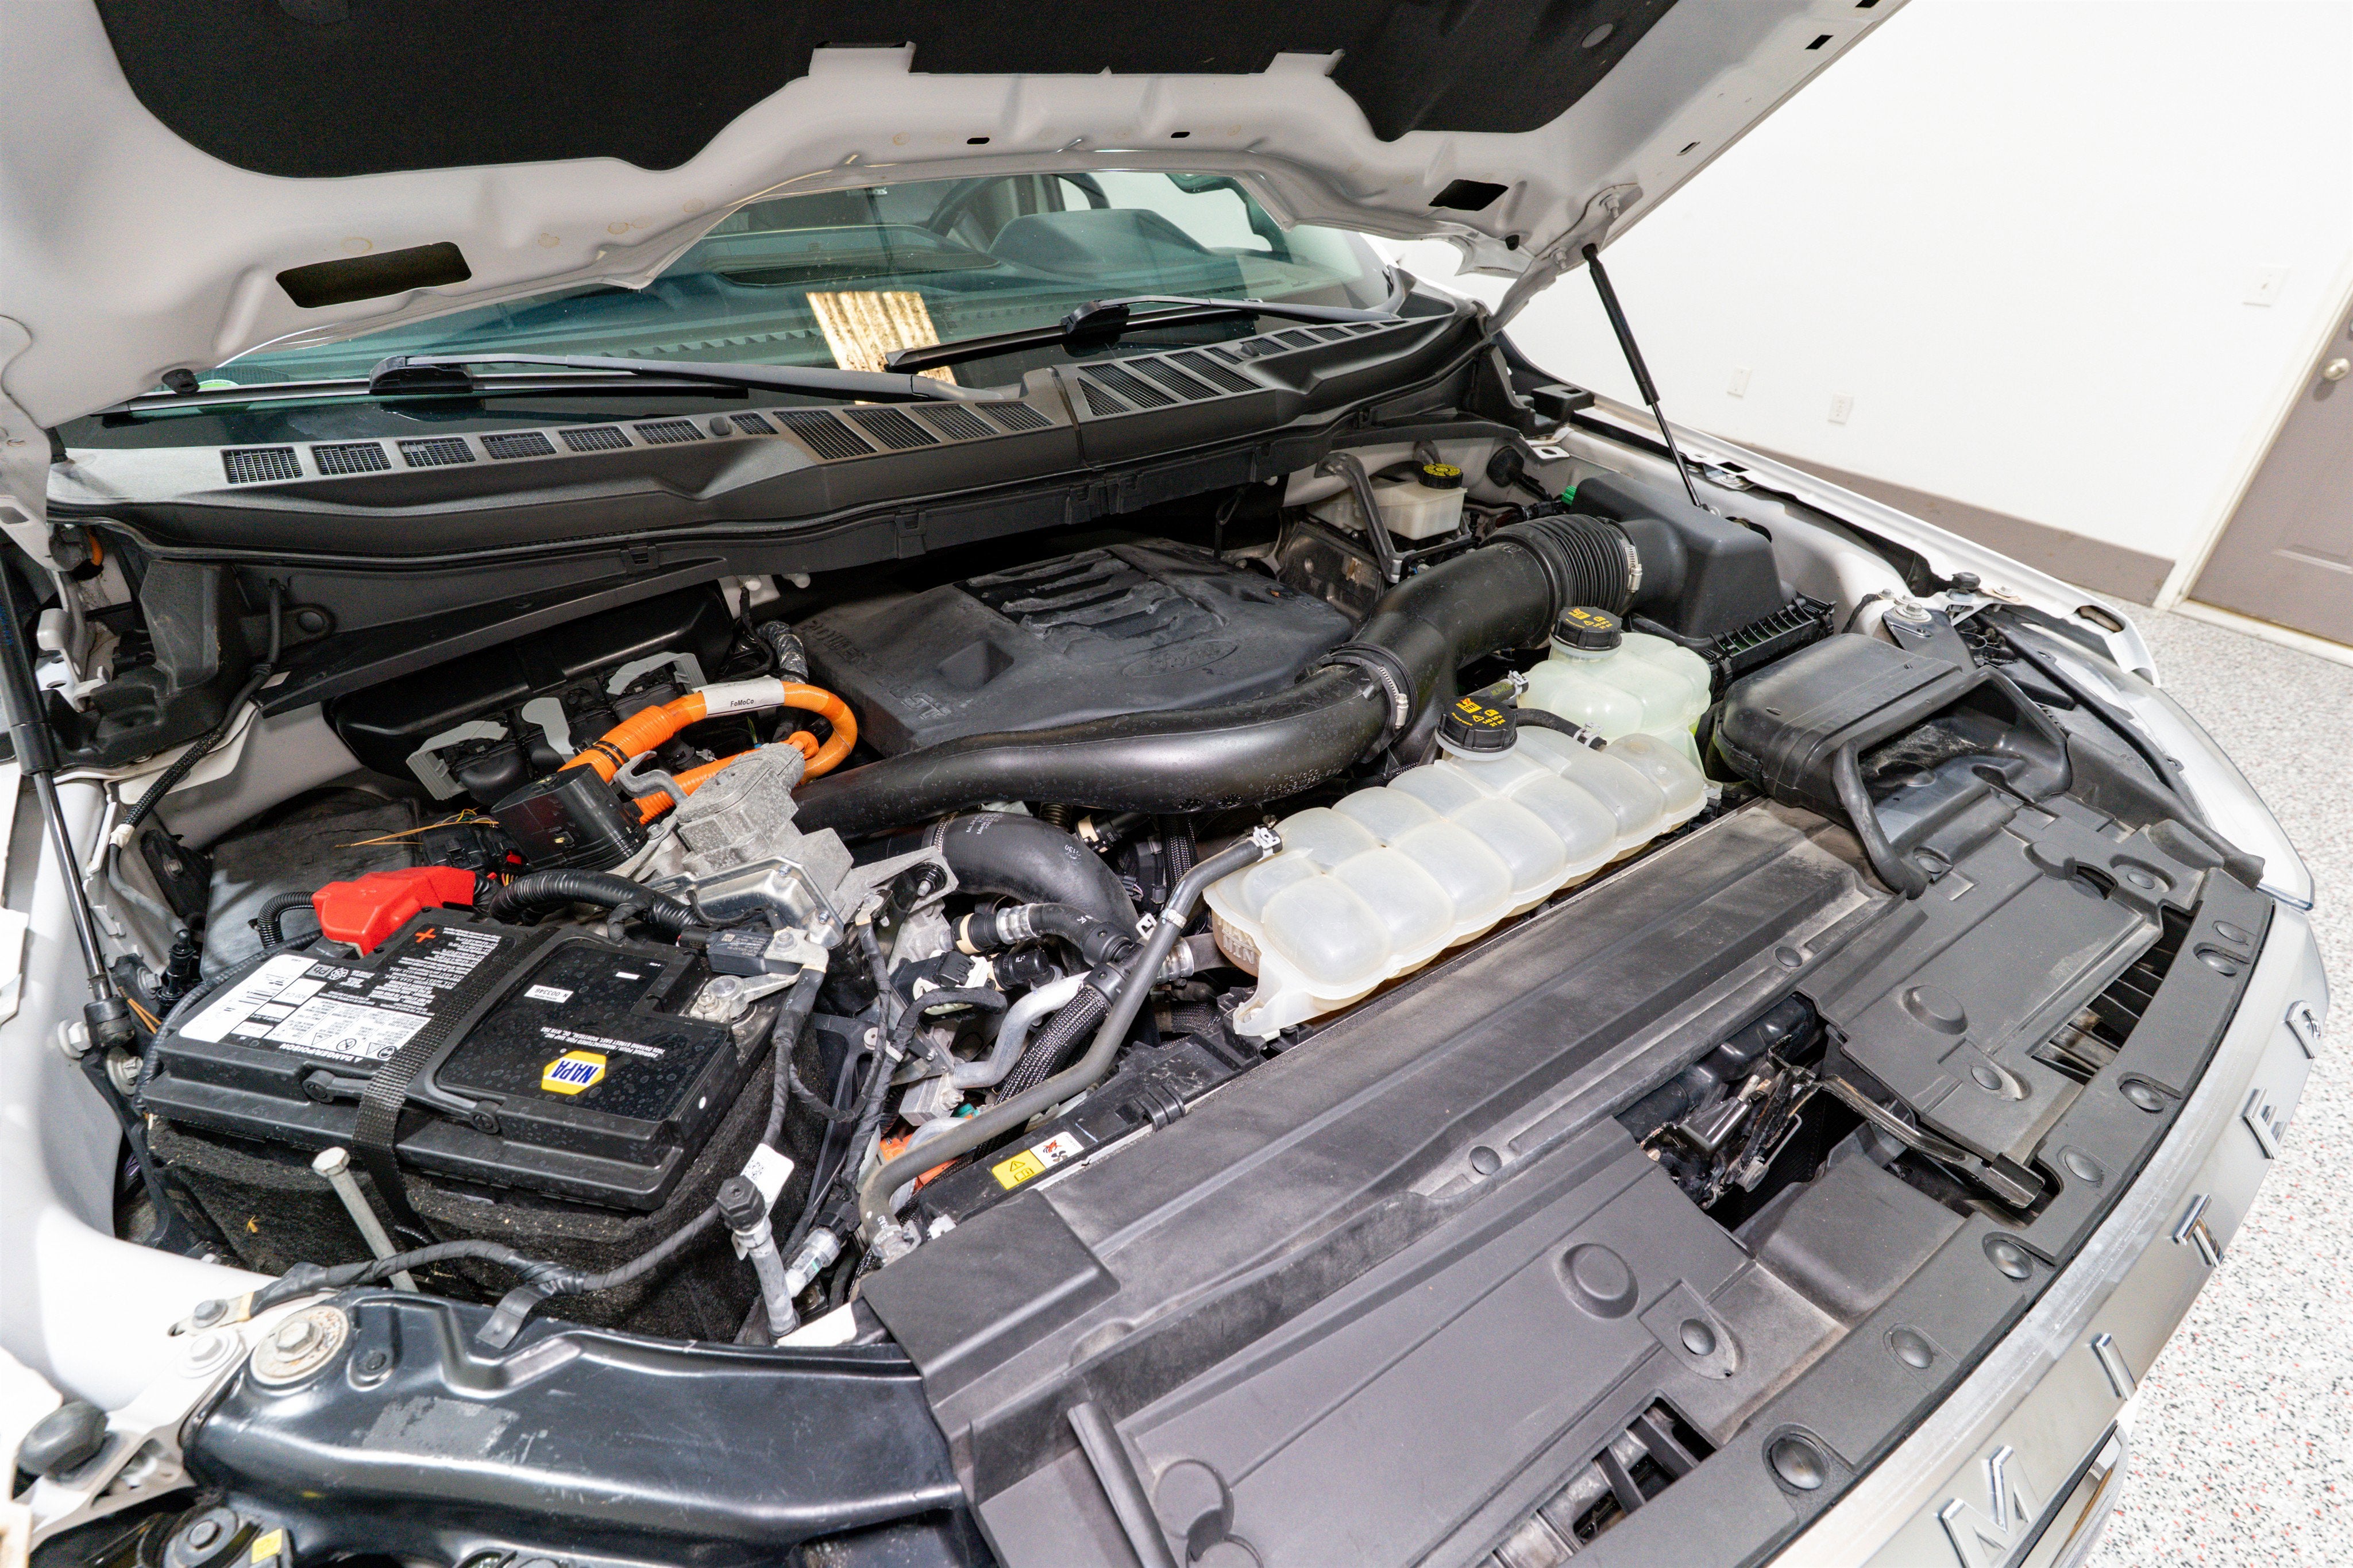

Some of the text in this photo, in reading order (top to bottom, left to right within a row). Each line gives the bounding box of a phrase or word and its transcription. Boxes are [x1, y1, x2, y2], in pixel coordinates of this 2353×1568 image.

[730, 698, 754, 707] FoMoCo
[1223, 935, 1255, 964] MIN
[314, 967, 330, 975] Pb
[535, 988, 561, 997] 003346
[576, 1039, 617, 1050] MANUFACTURED
[612, 1039, 632, 1047] STREET
[631, 1042, 654, 1052] ONTARIO
[279, 1042, 355, 1062] DANGER/POISON
[551, 1060, 599, 1083] NAPA
